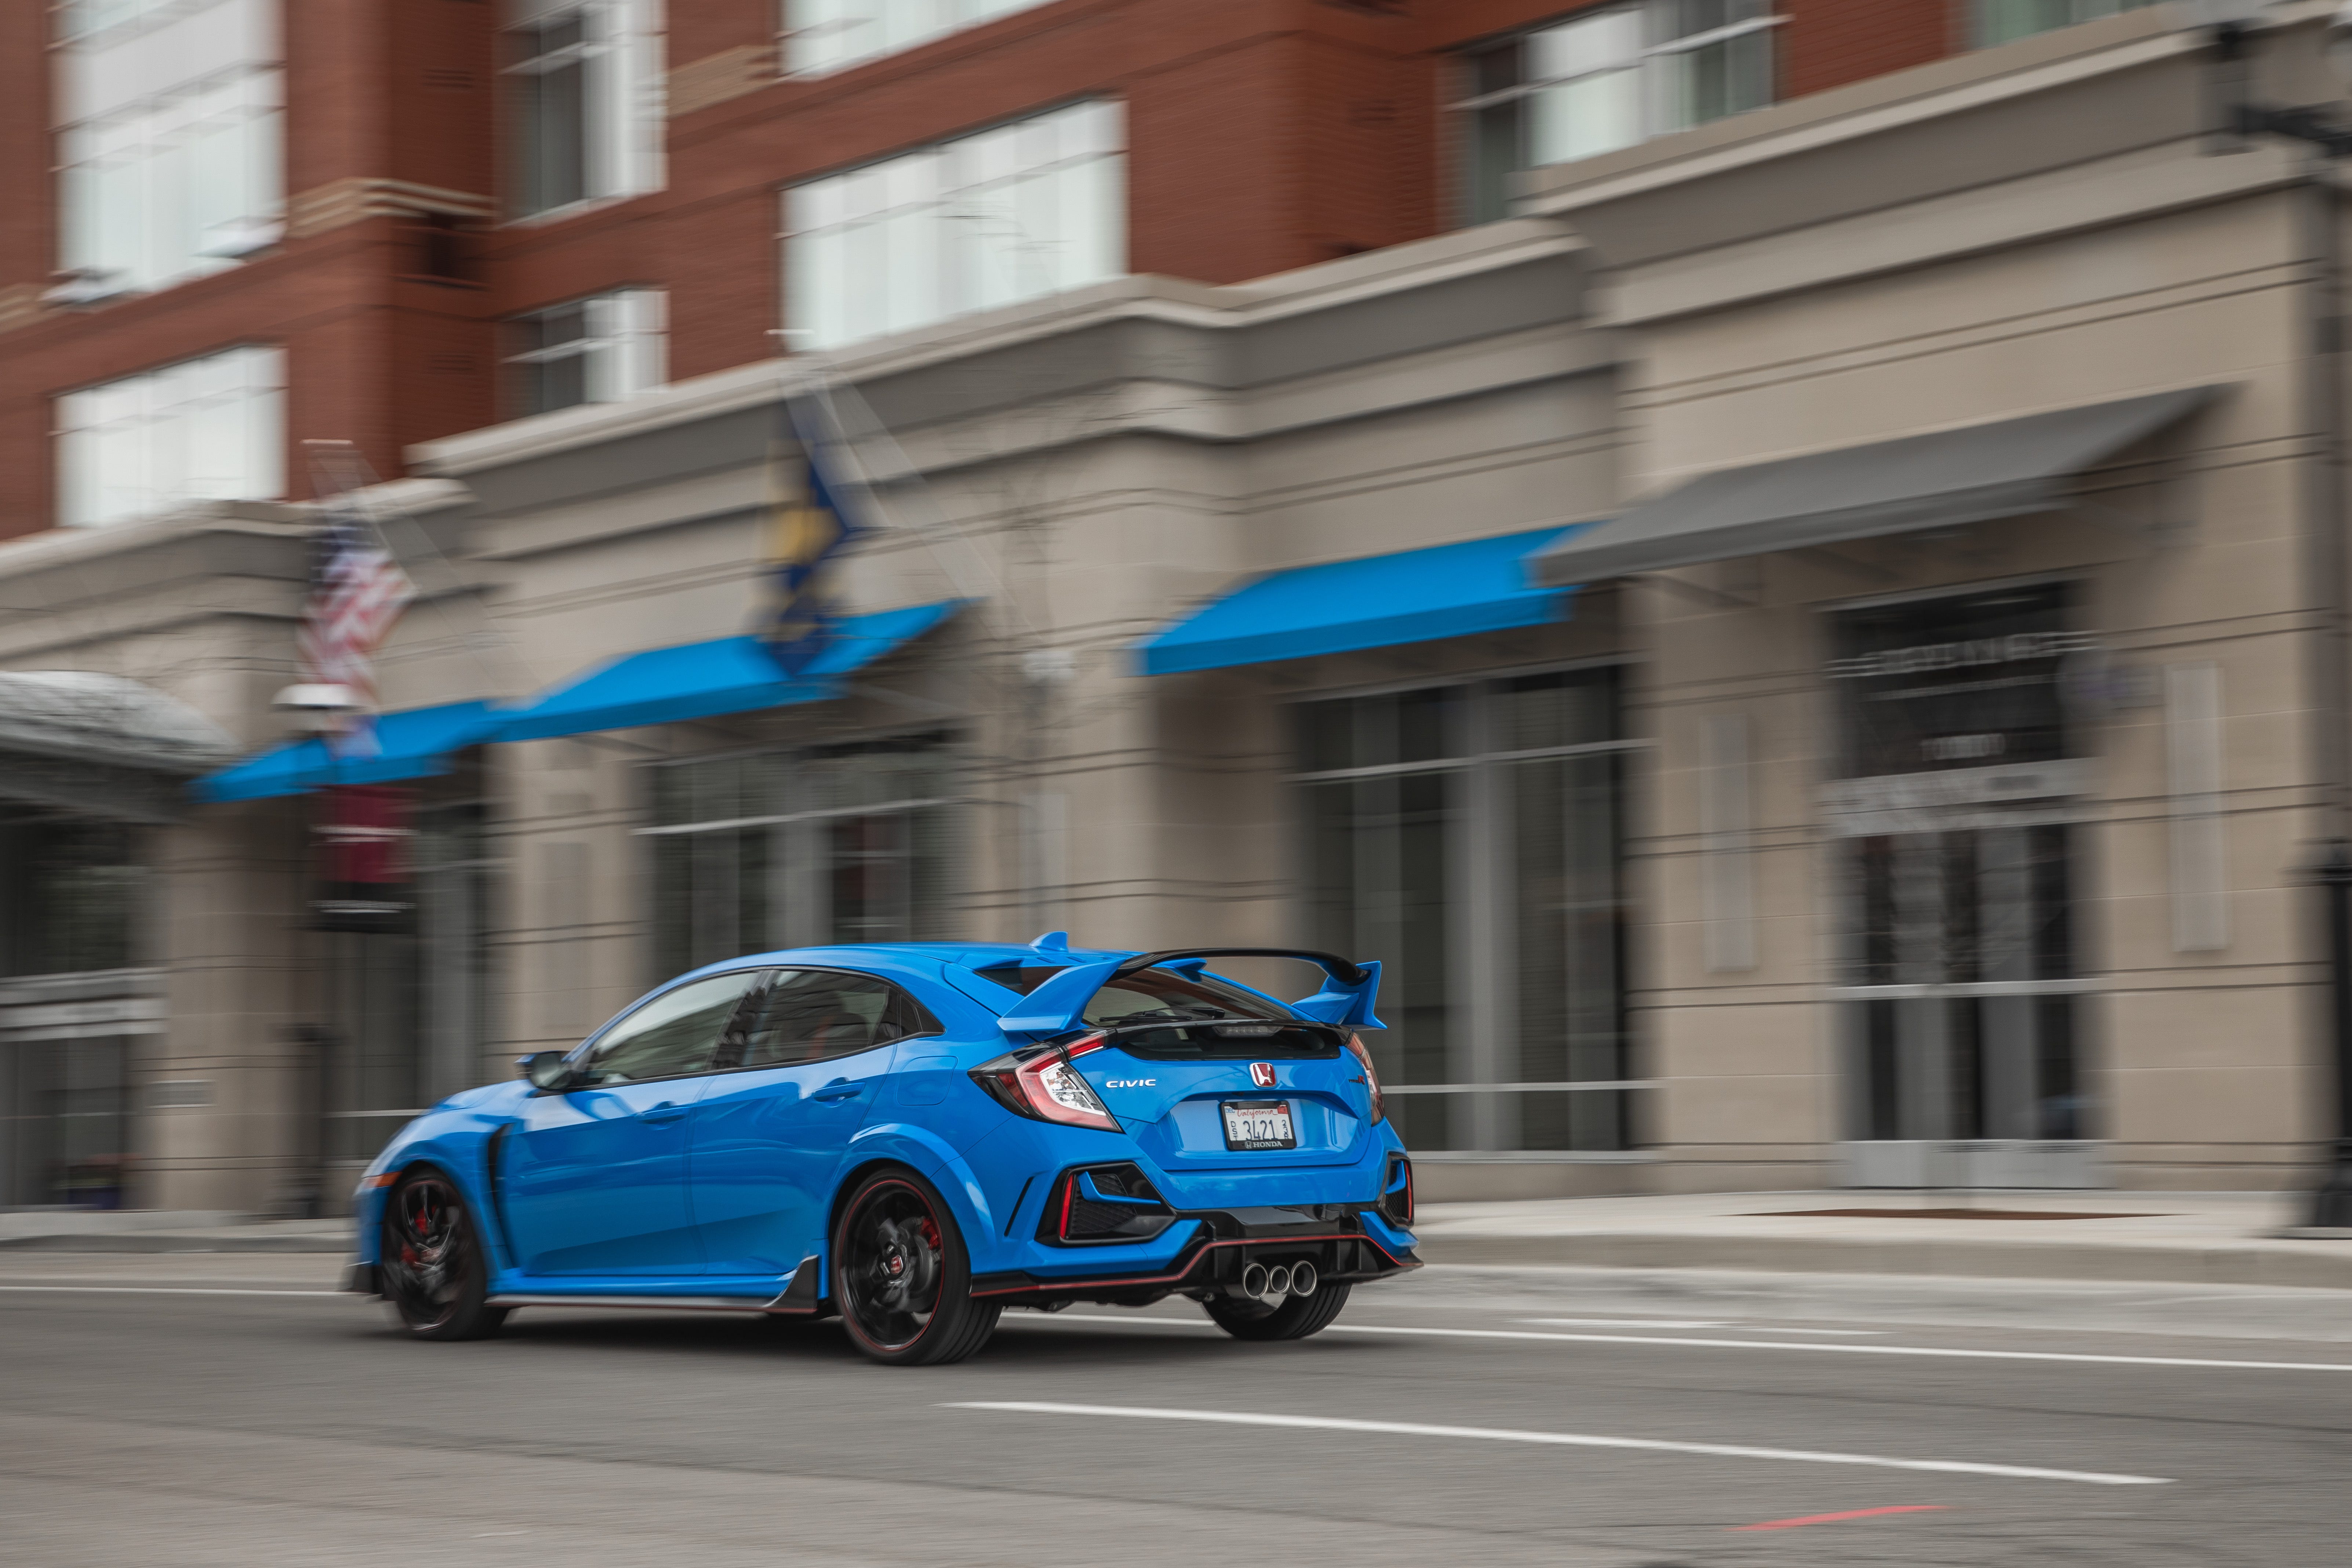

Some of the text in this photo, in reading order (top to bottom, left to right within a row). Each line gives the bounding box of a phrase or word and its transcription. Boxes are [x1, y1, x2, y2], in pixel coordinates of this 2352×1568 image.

[1106, 1079, 1156, 1088] CIVIC
[1237, 1109, 1278, 1119] California
[1243, 1120, 1279, 1140] 3421
